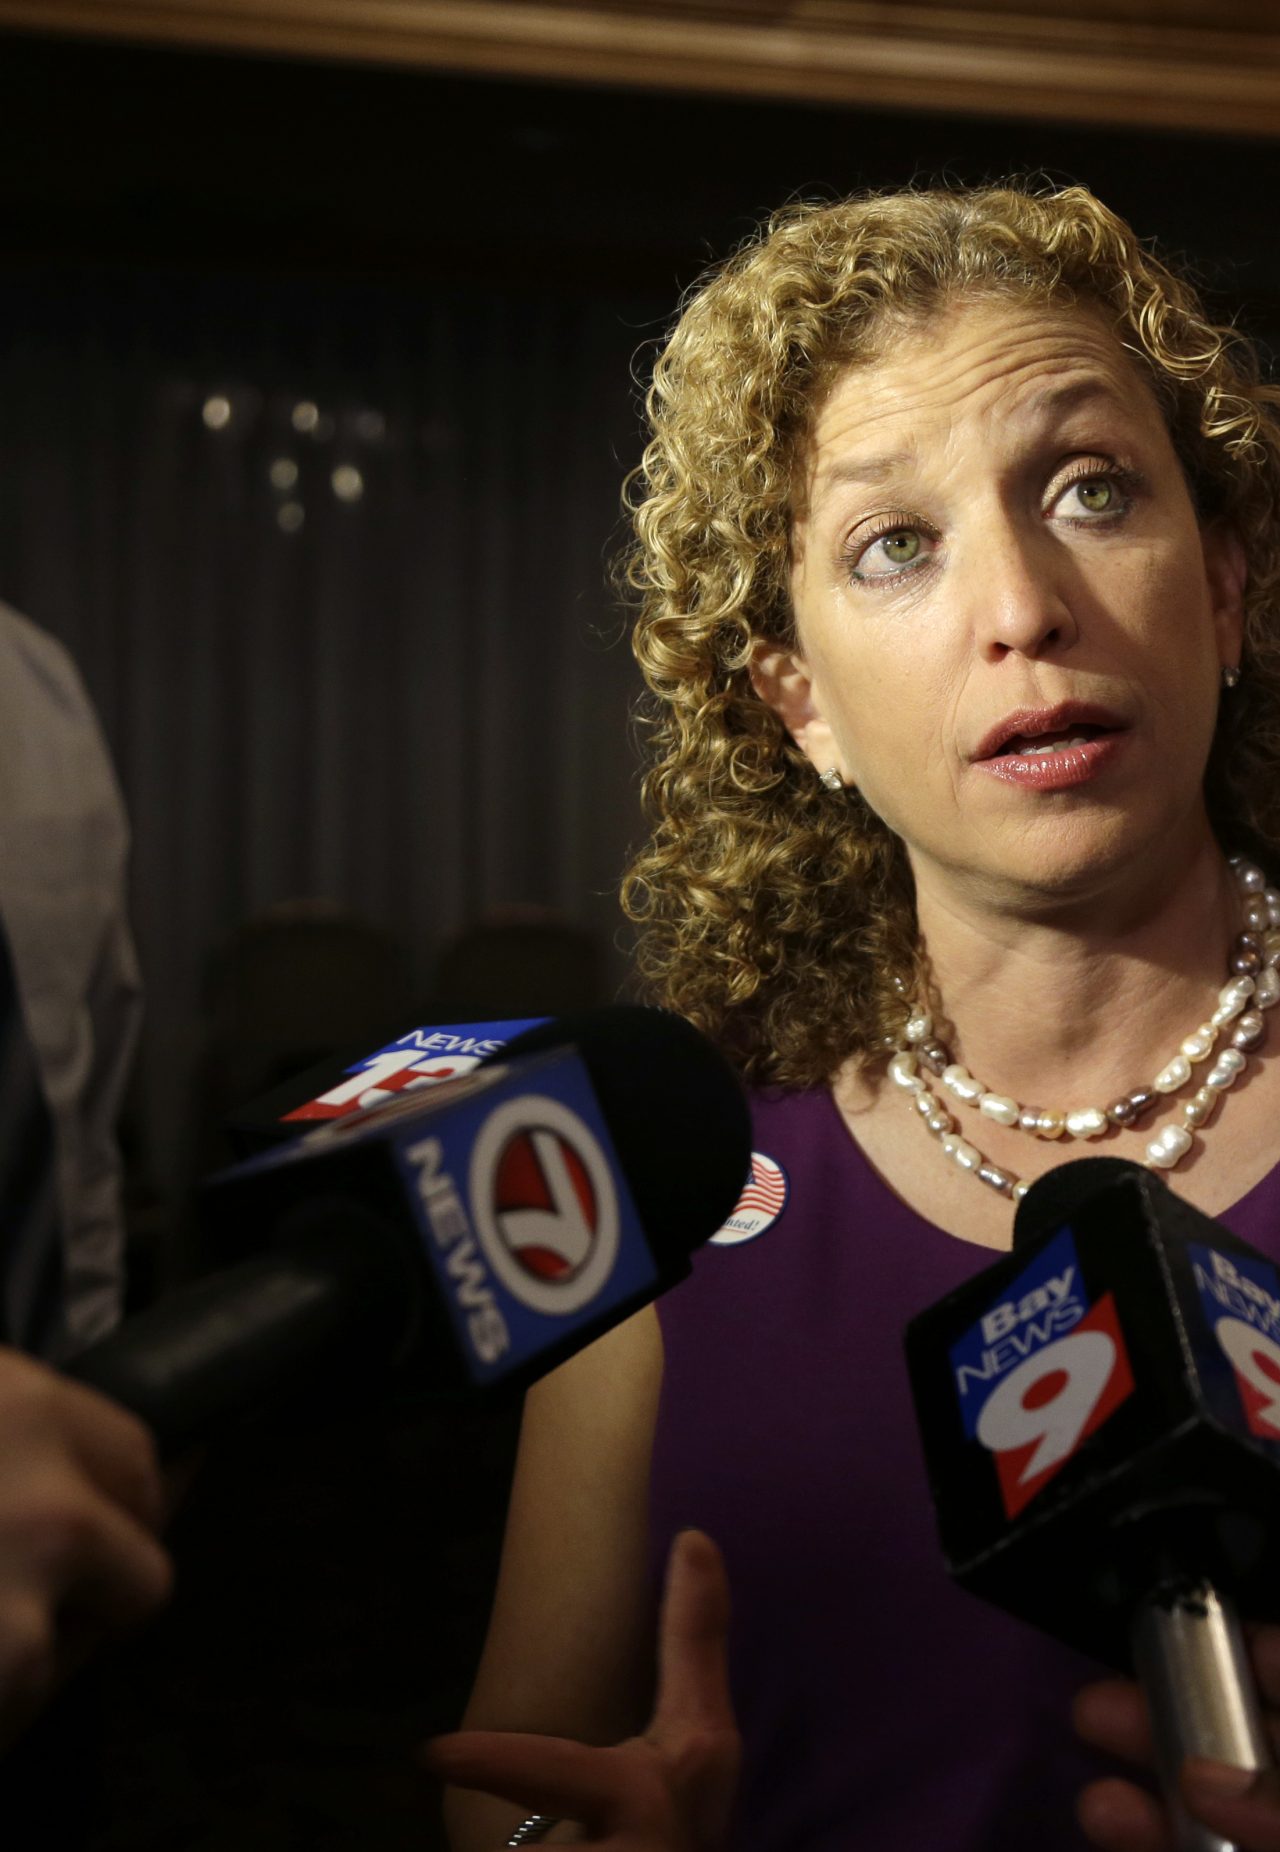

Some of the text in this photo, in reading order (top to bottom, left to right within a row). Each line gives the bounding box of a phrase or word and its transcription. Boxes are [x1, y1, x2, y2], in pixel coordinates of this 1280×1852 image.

[395, 1029, 508, 1057] NEWS
[406, 1137, 510, 1364] NEWS
[955, 1296, 1086, 1397] NEWS
[980, 1265, 1075, 1345] Bay
[976, 1330, 1116, 1487] 9
